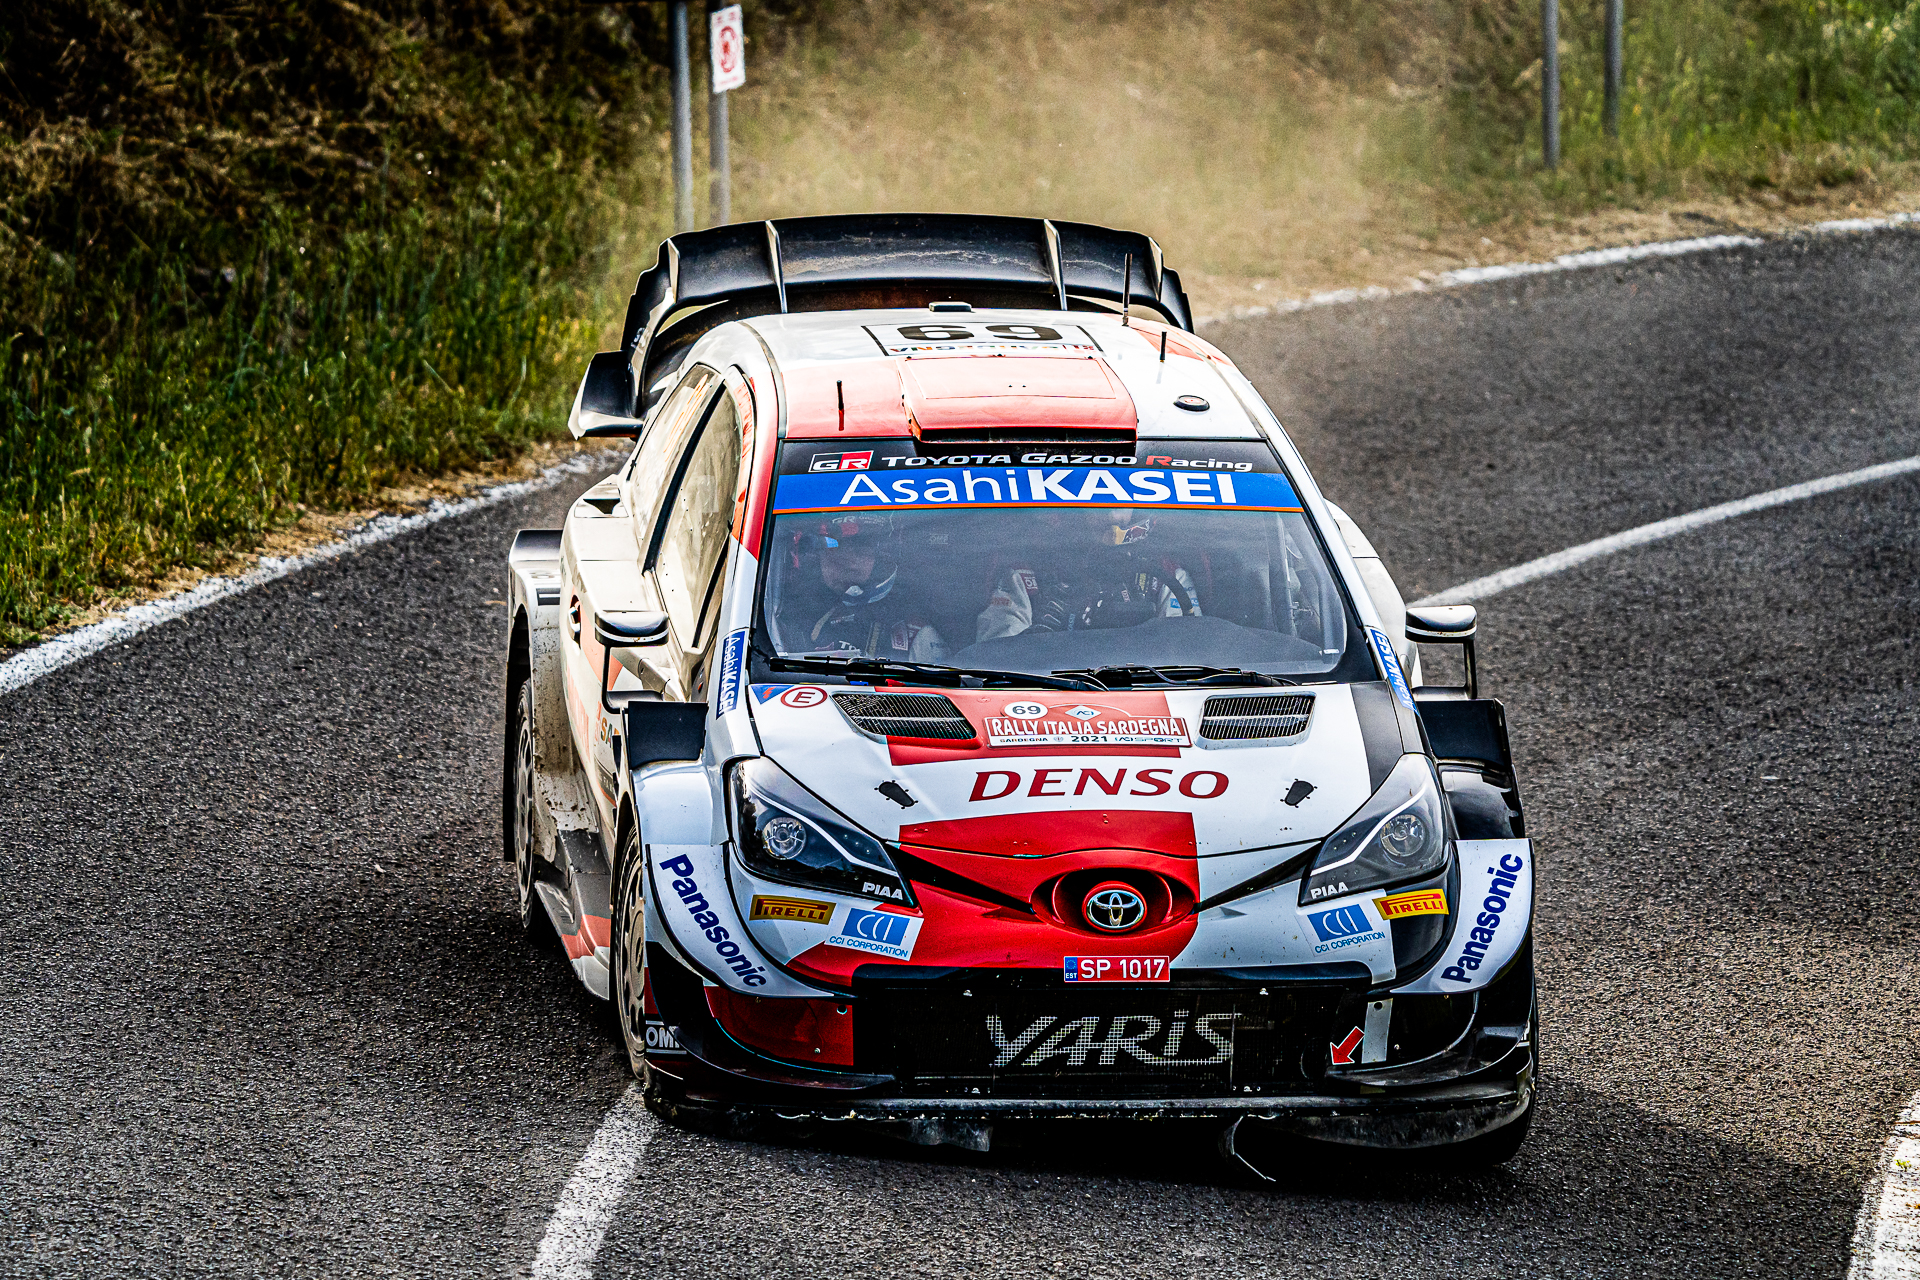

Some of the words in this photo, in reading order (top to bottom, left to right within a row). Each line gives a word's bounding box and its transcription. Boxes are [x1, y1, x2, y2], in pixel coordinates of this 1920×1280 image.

[897, 325, 1062, 340] 69
[812, 458, 868, 471] GR
[881, 455, 1012, 467] TOYOTA
[1020, 452, 1138, 466] GAZOO
[1145, 455, 1253, 472] Racing
[839, 468, 1238, 505] AsahiKASEI
[718, 636, 741, 715] AsahiKASEI
[792, 691, 816, 704] E
[1012, 705, 1042, 715] 69
[992, 718, 1039, 736] RALLY
[1044, 719, 1092, 736] ITALIA
[1099, 718, 1182, 736] SARDEGNA
[1071, 735, 1108, 743] 2021
[968, 768, 1230, 803] DENSO
[861, 881, 903, 901] PIAA
[1310, 881, 1350, 899] PIAA
[754, 898, 830, 921] PIRELLI
[1379, 893, 1444, 916] PIRELLI
[659, 853, 766, 988] Panasonic
[1440, 853, 1523, 984] Panasonic
[829, 935, 845, 945] CCI
[846, 938, 909, 958] CORPORATION
[1314, 944, 1331, 954] CCI
[1331, 931, 1386, 951] CORPORATION
[1080, 958, 1111, 979] SP
[1119, 958, 1166, 979] 1017
